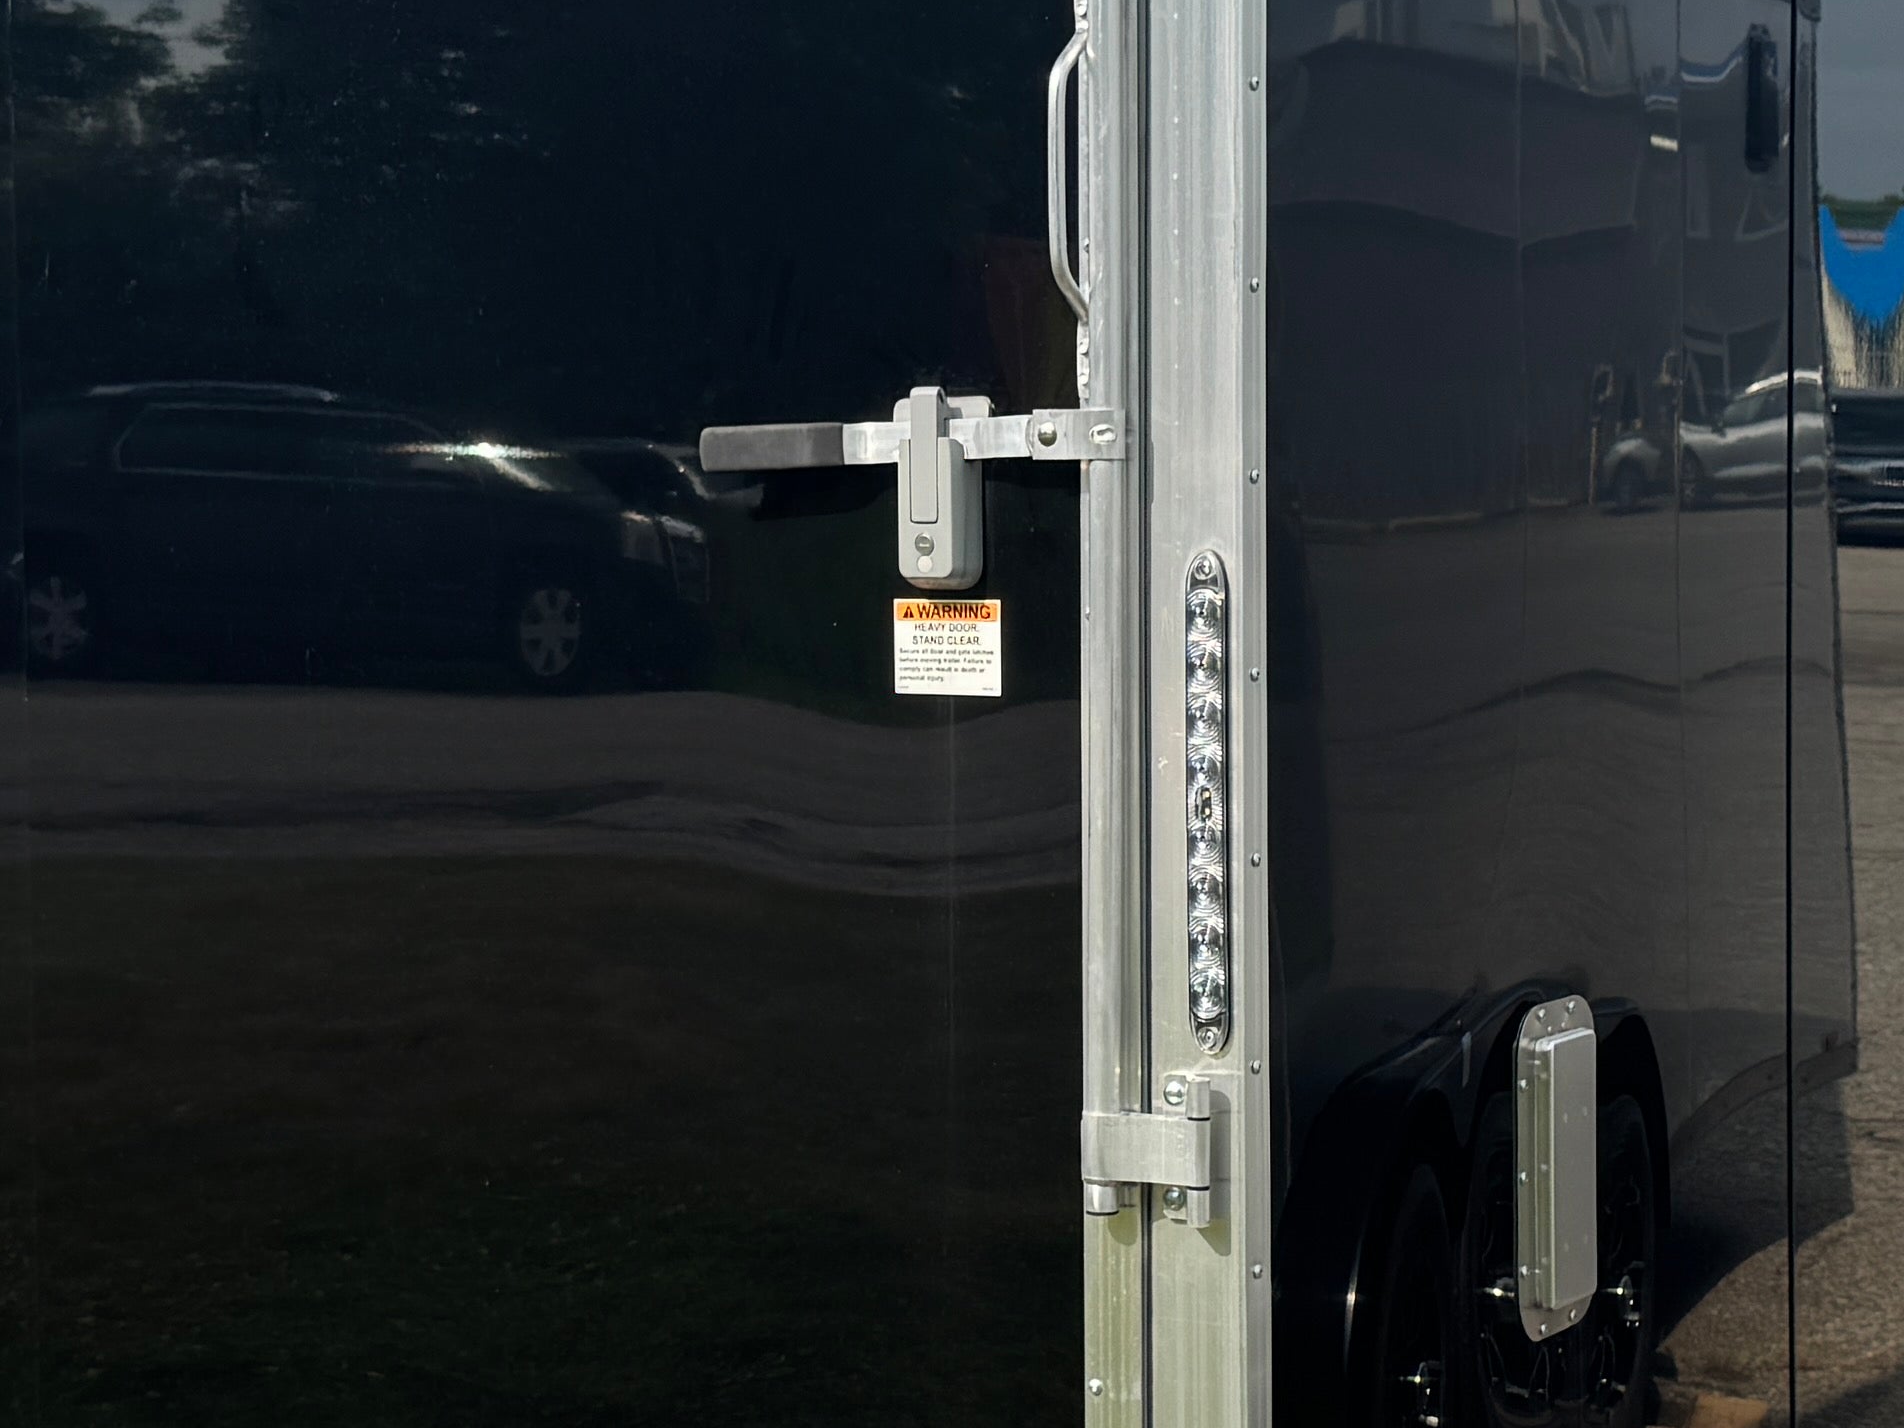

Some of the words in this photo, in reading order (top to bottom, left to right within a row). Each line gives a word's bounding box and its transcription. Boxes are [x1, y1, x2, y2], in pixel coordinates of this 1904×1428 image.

[916, 603, 991, 619] WARNING
[915, 623, 946, 631] HEAVY
[912, 636, 944, 645] STAND
